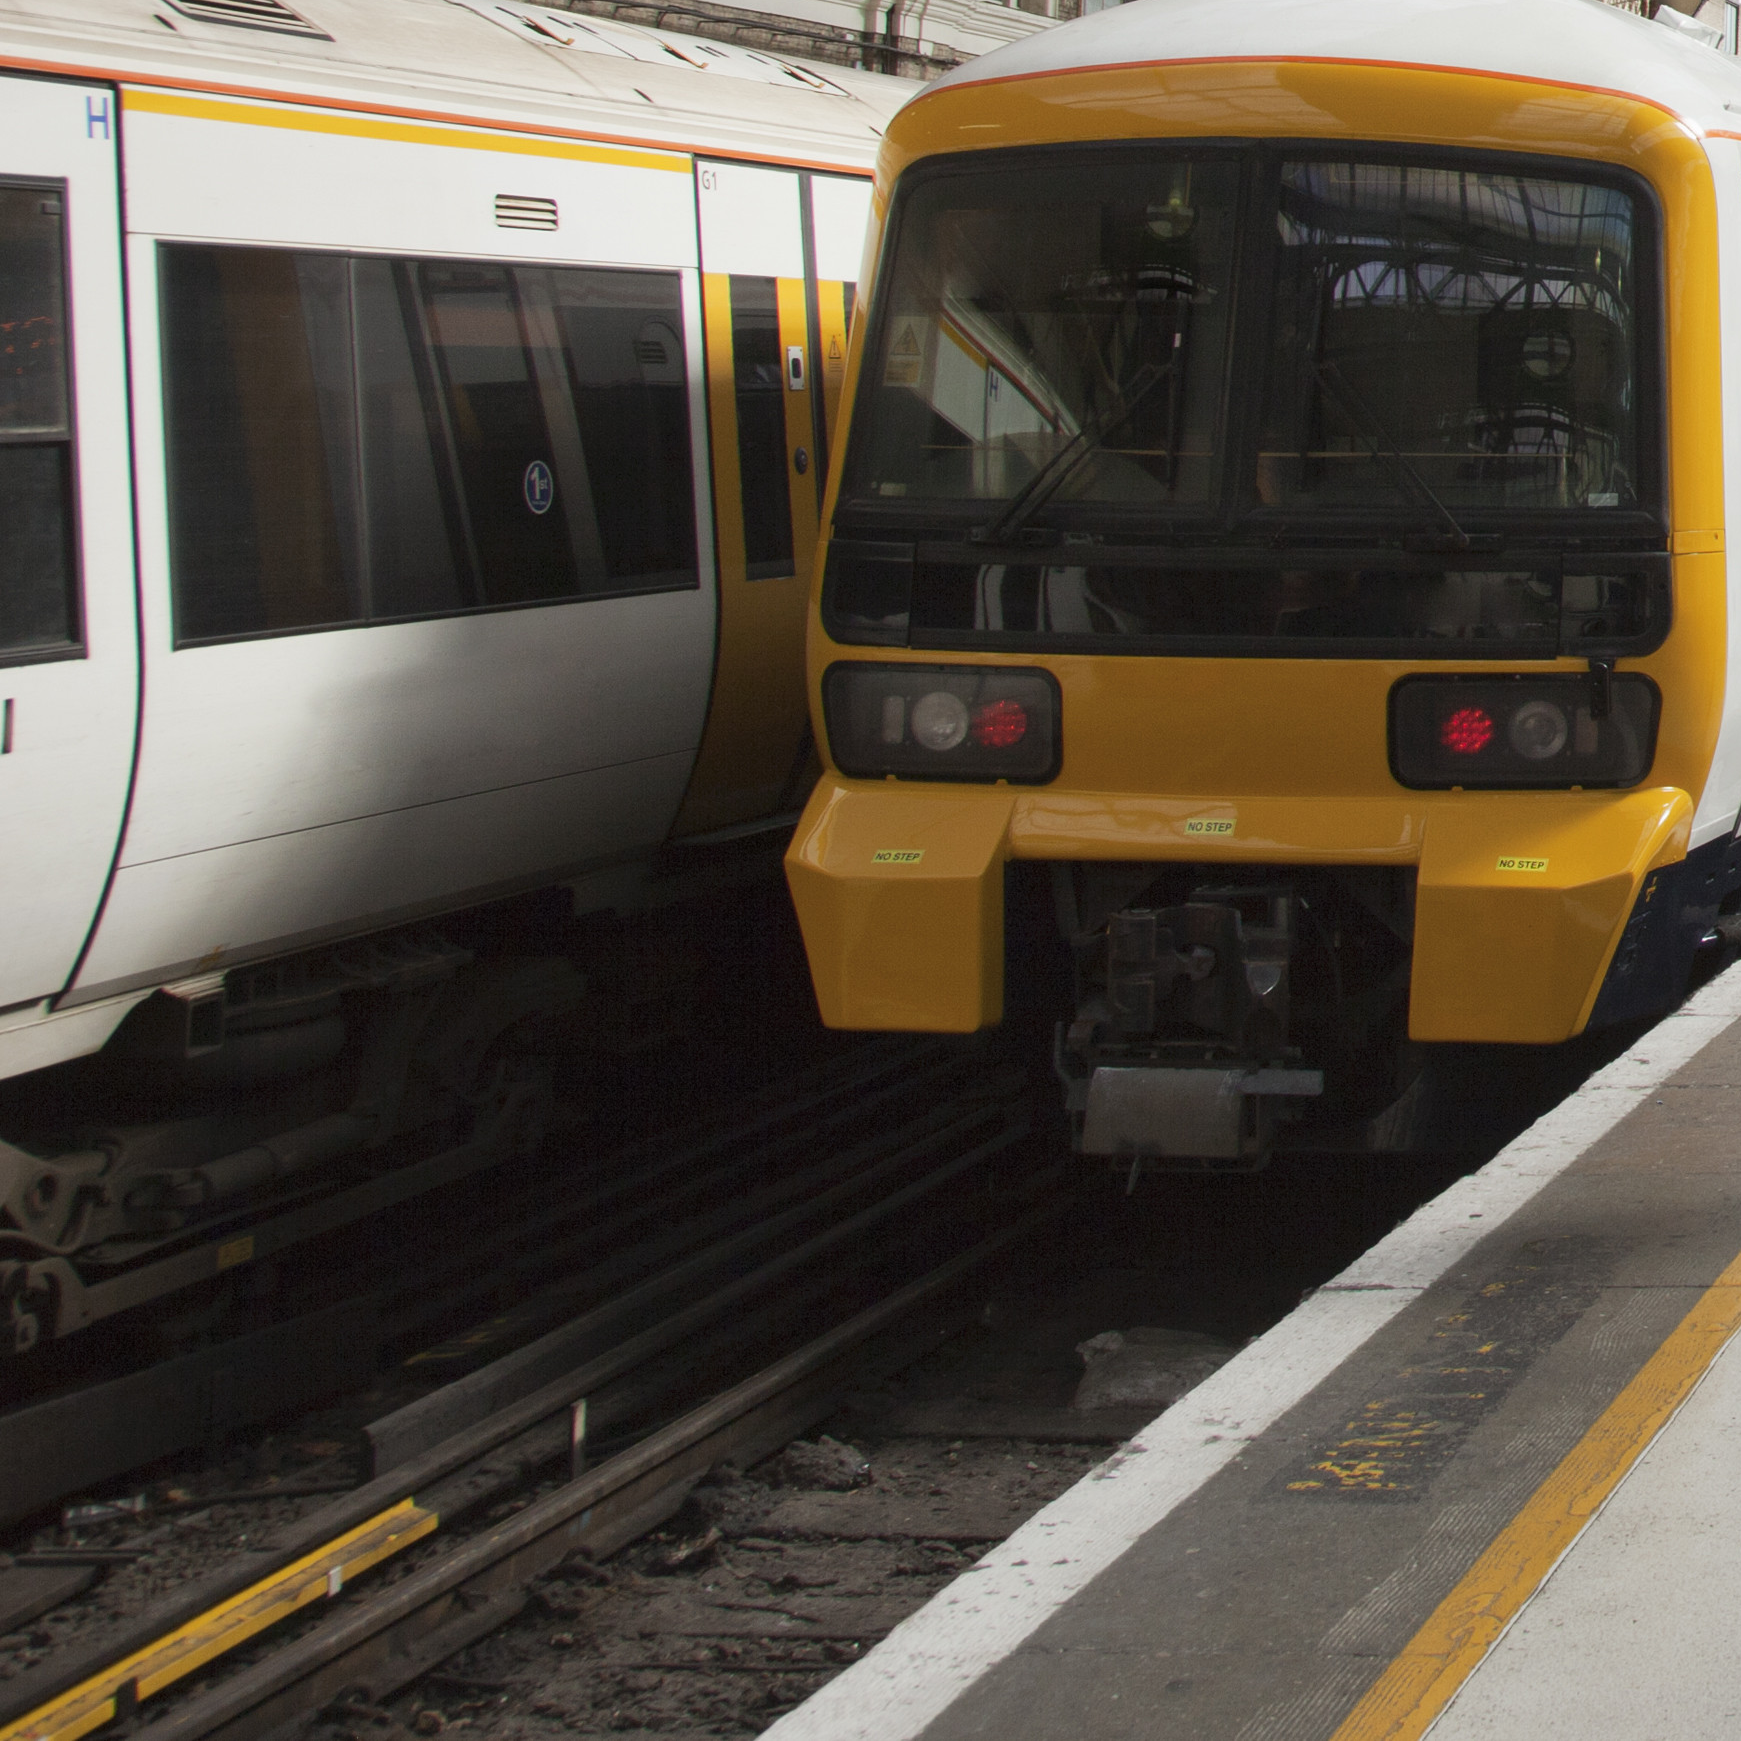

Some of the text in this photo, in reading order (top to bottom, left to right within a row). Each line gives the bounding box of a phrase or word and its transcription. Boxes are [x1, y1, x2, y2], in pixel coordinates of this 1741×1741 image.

[86, 96, 109, 140] H
[702, 170, 717, 190] G1
[529, 466, 548, 500] 1st
[1187, 822, 1233, 832] NO STEP
[875, 852, 921, 861] NO STEP
[1499, 859, 1545, 869] NO STEP
